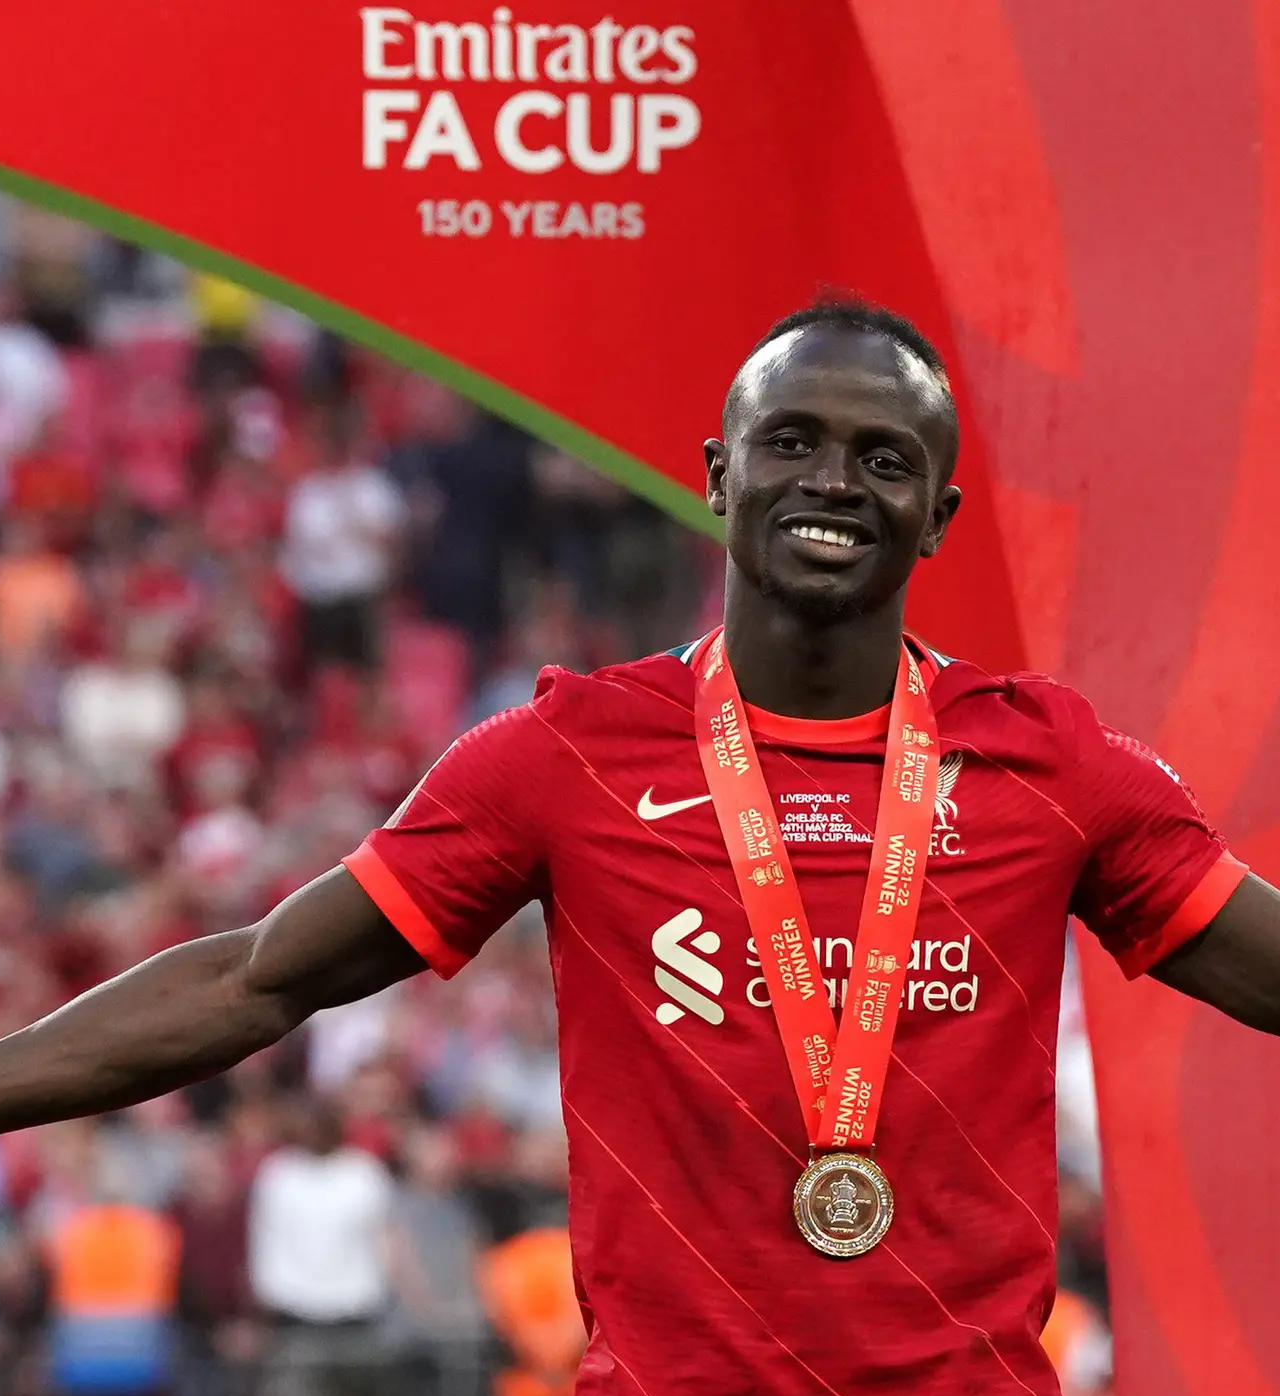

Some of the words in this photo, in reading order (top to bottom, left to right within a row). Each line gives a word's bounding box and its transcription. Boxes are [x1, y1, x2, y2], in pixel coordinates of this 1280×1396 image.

[361, 7, 697, 84] Emirates
[363, 90, 481, 170] FA
[494, 91, 701, 173] CUP
[418, 200, 492, 237] 150
[502, 202, 645, 238] YEARS
[710, 715, 732, 768] 2021-22
[721, 698, 750, 776] WINNER
[901, 751, 916, 768] FA
[780, 794, 835, 804] LIVERPOOL
[836, 794, 851, 804] FC
[898, 771, 914, 802] CUP
[912, 753, 928, 803] Emirates
[738, 811, 760, 860] Emirates
[748, 808, 767, 837] CUP
[785, 813, 829, 823] CHELSEA
[830, 813, 844, 823] FC
[806, 823, 827, 833] MAY
[829, 823, 853, 833] 2022
[809, 833, 820, 843] FA
[822, 833, 843, 843] CUP
[845, 833, 874, 843] FINAL
[758, 838, 773, 857] FA
[876, 834, 905, 916] WINNER
[896, 848, 916, 906] 2021-22
[771, 933, 797, 991] 2021-22
[781, 917, 816, 1001] WINNER
[864, 979, 879, 998] FA
[870, 981, 891, 1032] Emirates
[858, 999, 876, 1032] CUP
[802, 1036, 824, 1089] Emirates
[812, 1034, 831, 1065] CUP
[831, 1067, 861, 1147] WINNER
[851, 1080, 872, 1139] 2021-22
